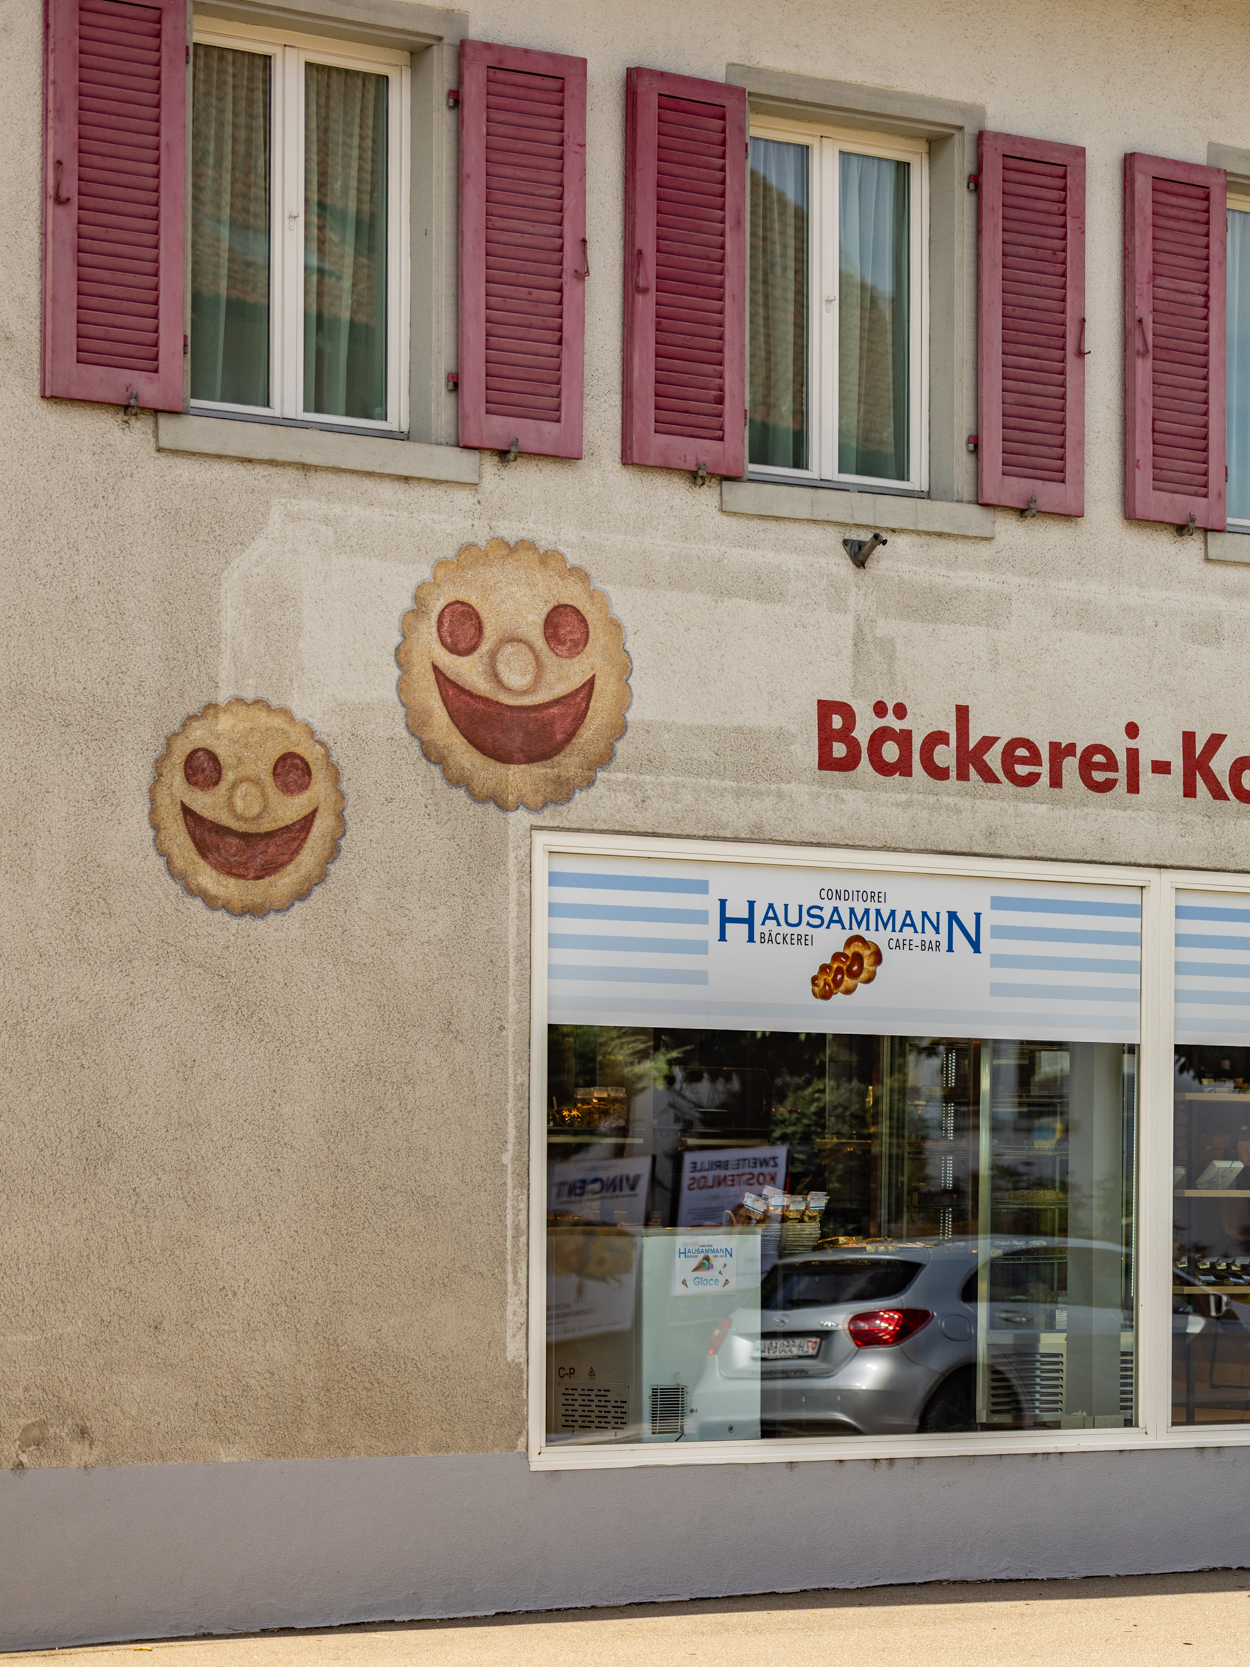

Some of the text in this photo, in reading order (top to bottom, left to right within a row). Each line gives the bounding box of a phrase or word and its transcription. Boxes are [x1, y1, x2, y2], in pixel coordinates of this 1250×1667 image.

[818, 887, 888, 904] CONDITOREI
[717, 898, 982, 954] HAUSAMMANN
[759, 930, 815, 947] BÄCKEREI
[887, 936, 942, 953] CAFE-BAR
[678, 1247, 733, 1259] HAUSAMMANN
[693, 1276, 720, 1287] Glace
